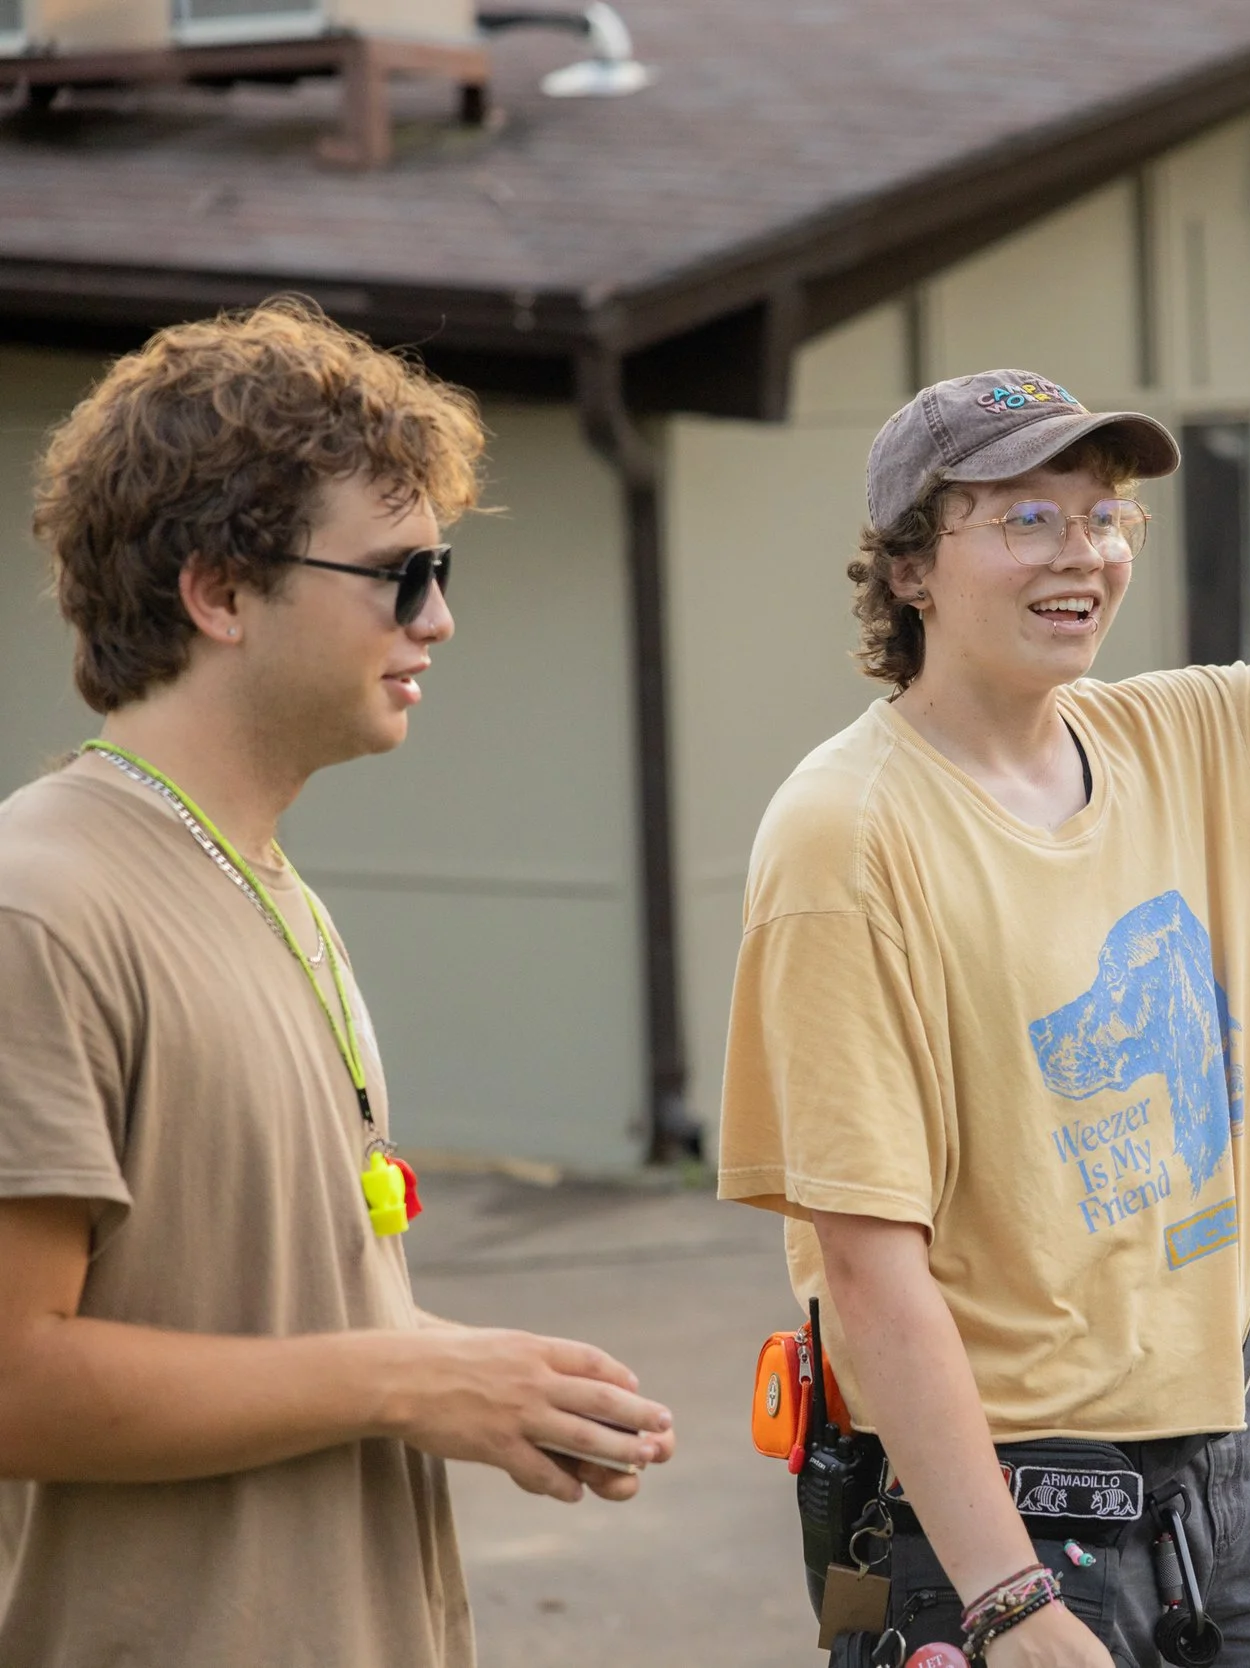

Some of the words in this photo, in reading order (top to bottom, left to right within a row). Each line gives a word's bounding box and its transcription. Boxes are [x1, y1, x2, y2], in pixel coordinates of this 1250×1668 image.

[977, 384, 1037, 407] CAMP
[1052, 1098, 1151, 1165] Weezer
[1077, 1159, 1109, 1196] Is
[1109, 1138, 1152, 1181] My
[1077, 1160, 1172, 1236] Friend
[1040, 1472, 1121, 1489] ARMADILLO
